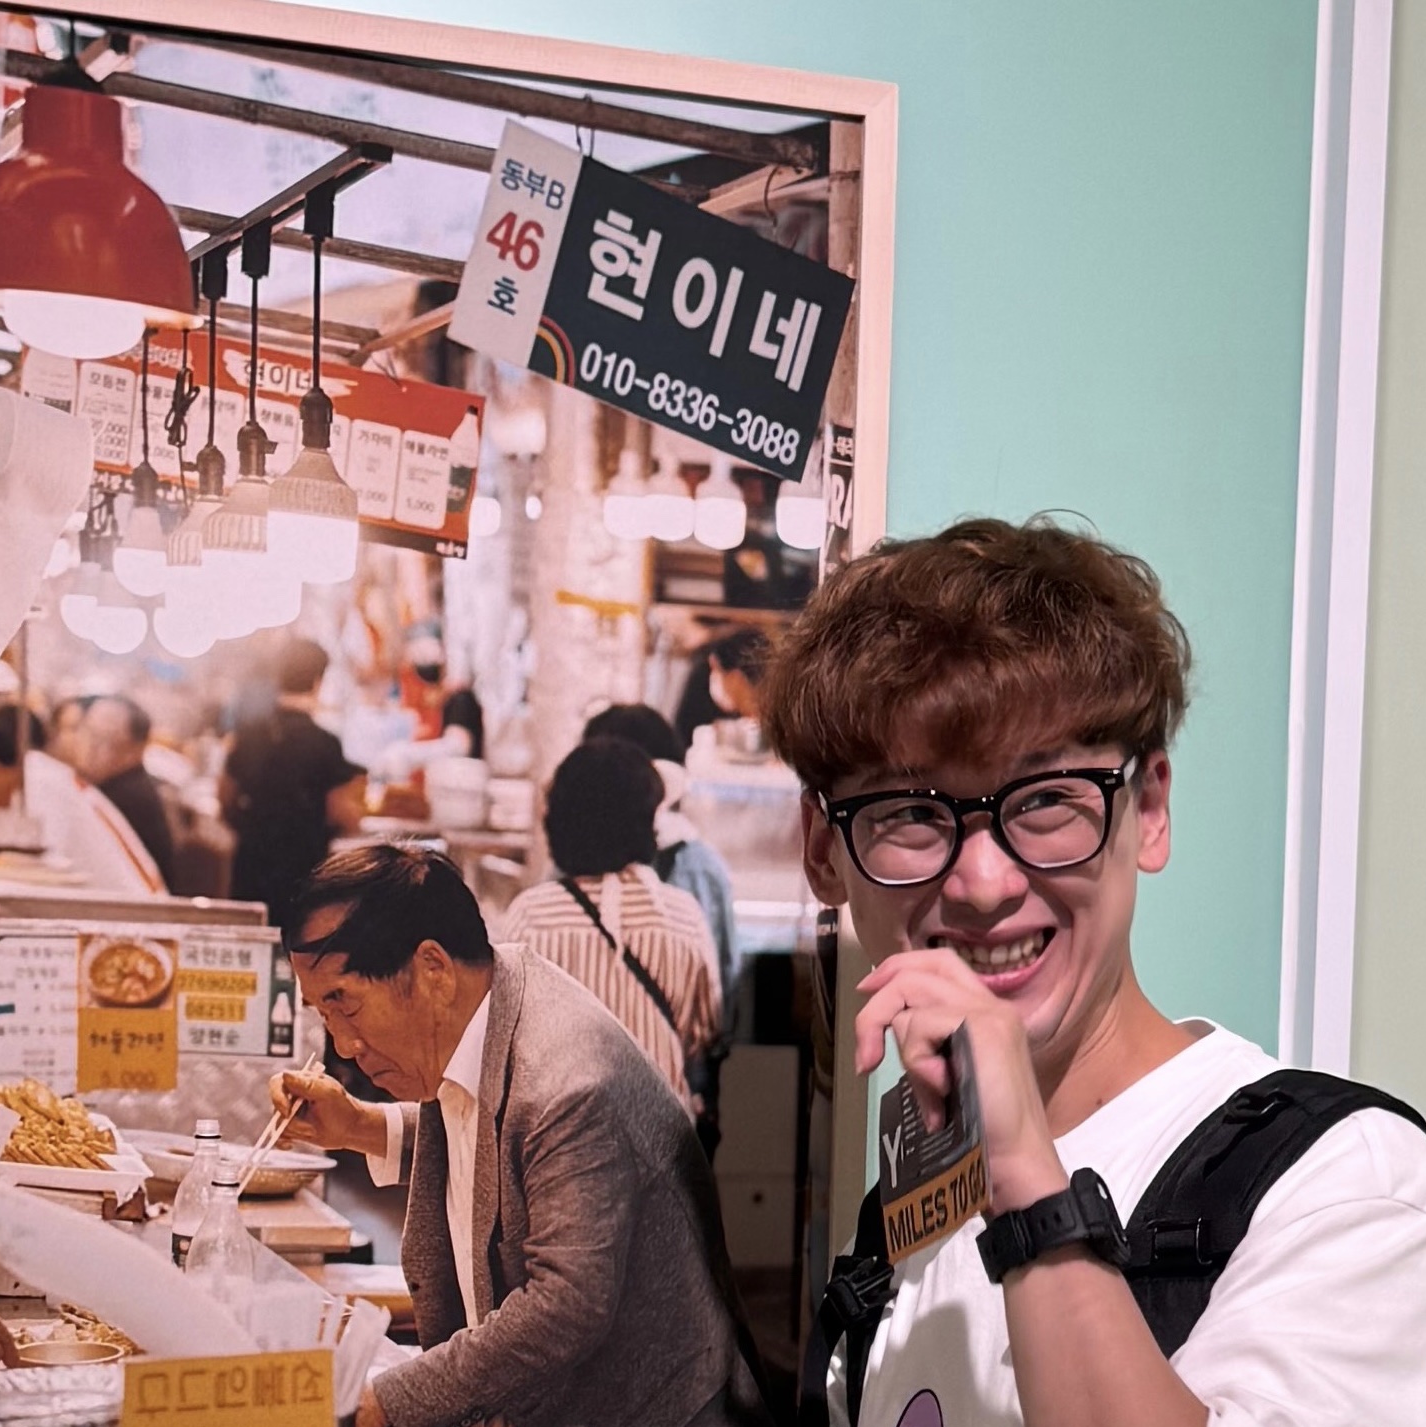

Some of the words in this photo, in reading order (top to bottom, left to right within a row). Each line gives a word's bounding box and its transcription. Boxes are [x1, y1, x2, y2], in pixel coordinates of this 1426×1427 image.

[501, 158, 566, 211] 동부B
[486, 211, 544, 271] 46
[488, 276, 519, 316] 호
[587, 209, 822, 392] 현이네
[580, 343, 800, 465] 010-8336-3088
[888, 1186, 948, 1254] MILES
[949, 1171, 969, 1221] TO
[968, 1159, 987, 1205] GO
